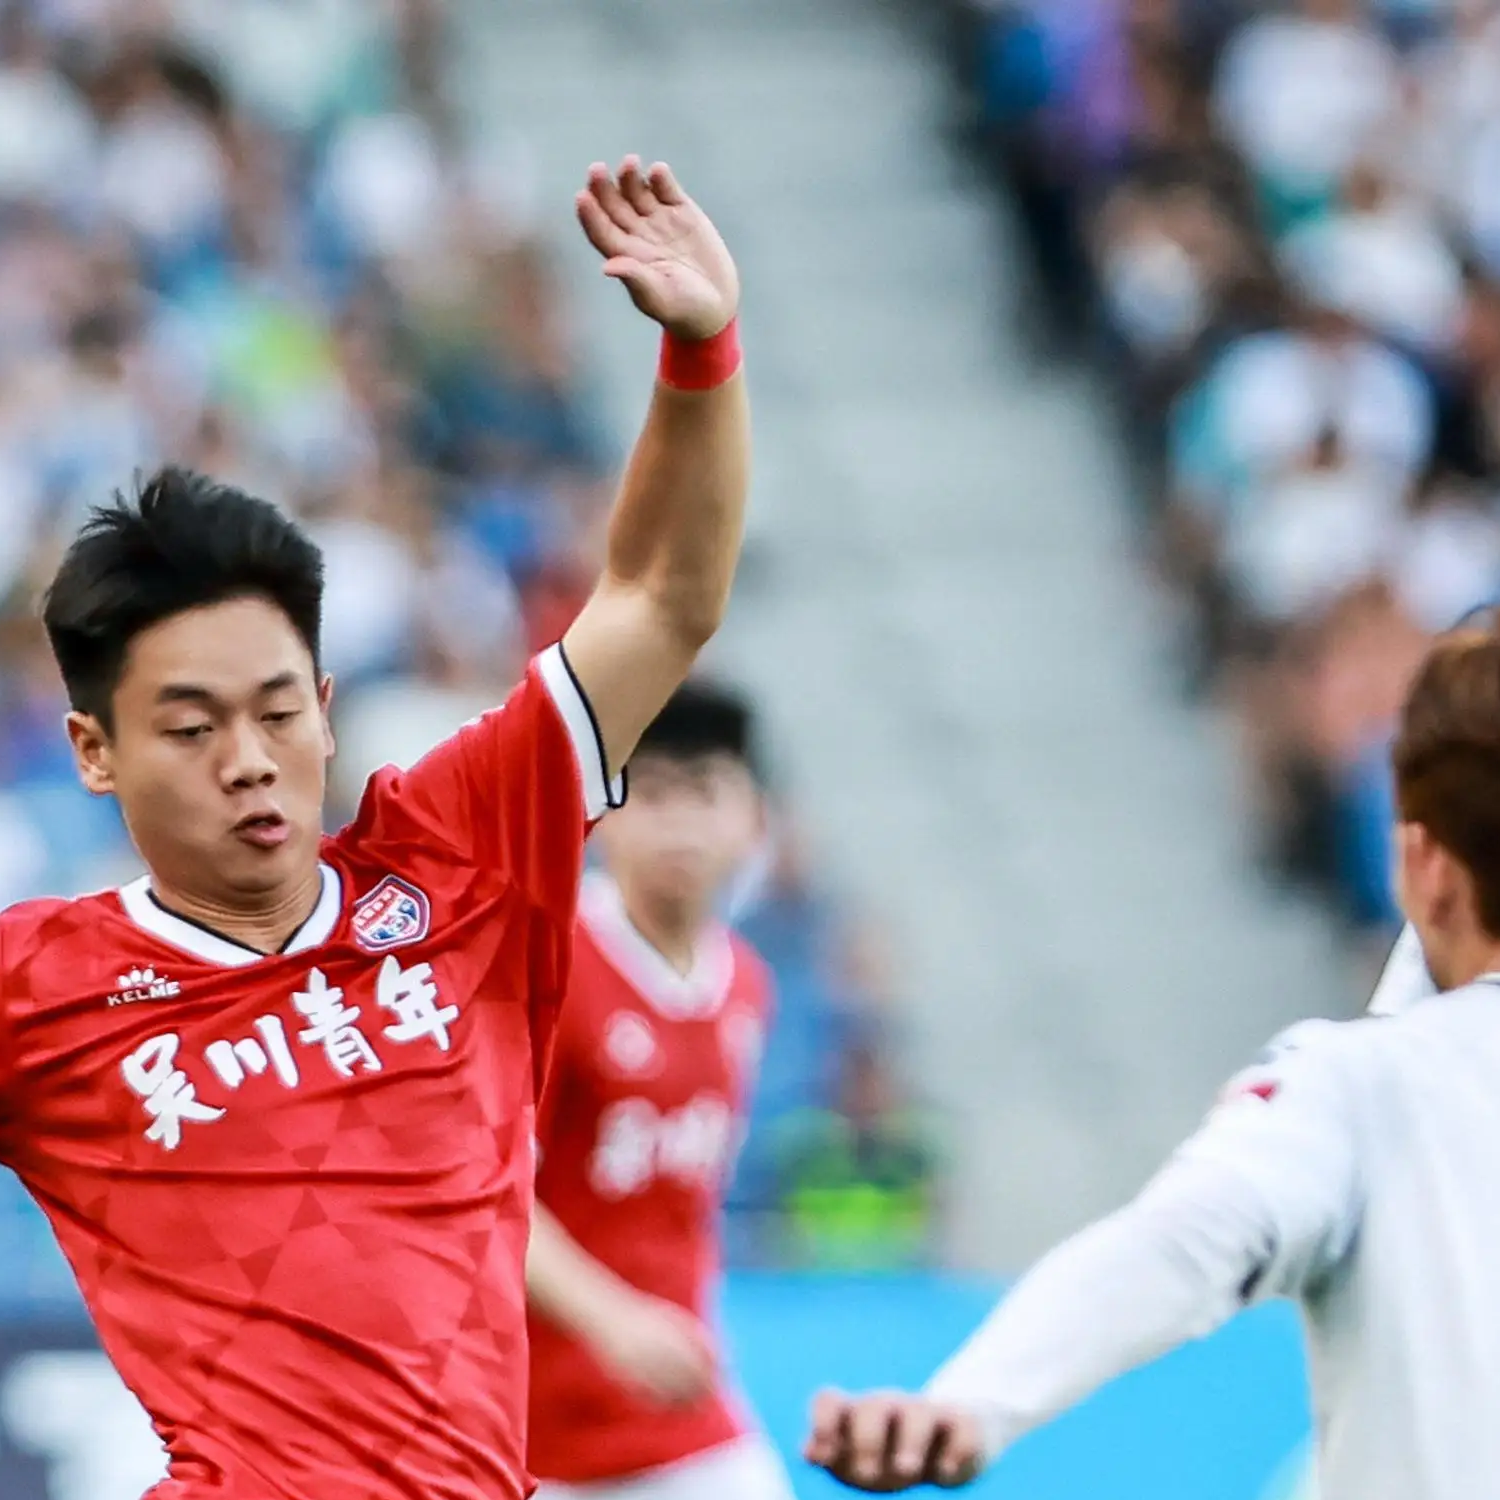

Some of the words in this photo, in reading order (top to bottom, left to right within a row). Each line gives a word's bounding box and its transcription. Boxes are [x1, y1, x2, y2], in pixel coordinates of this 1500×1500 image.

[106, 981, 181, 1007] KELME
[120, 954, 459, 1151] 吴川青年
